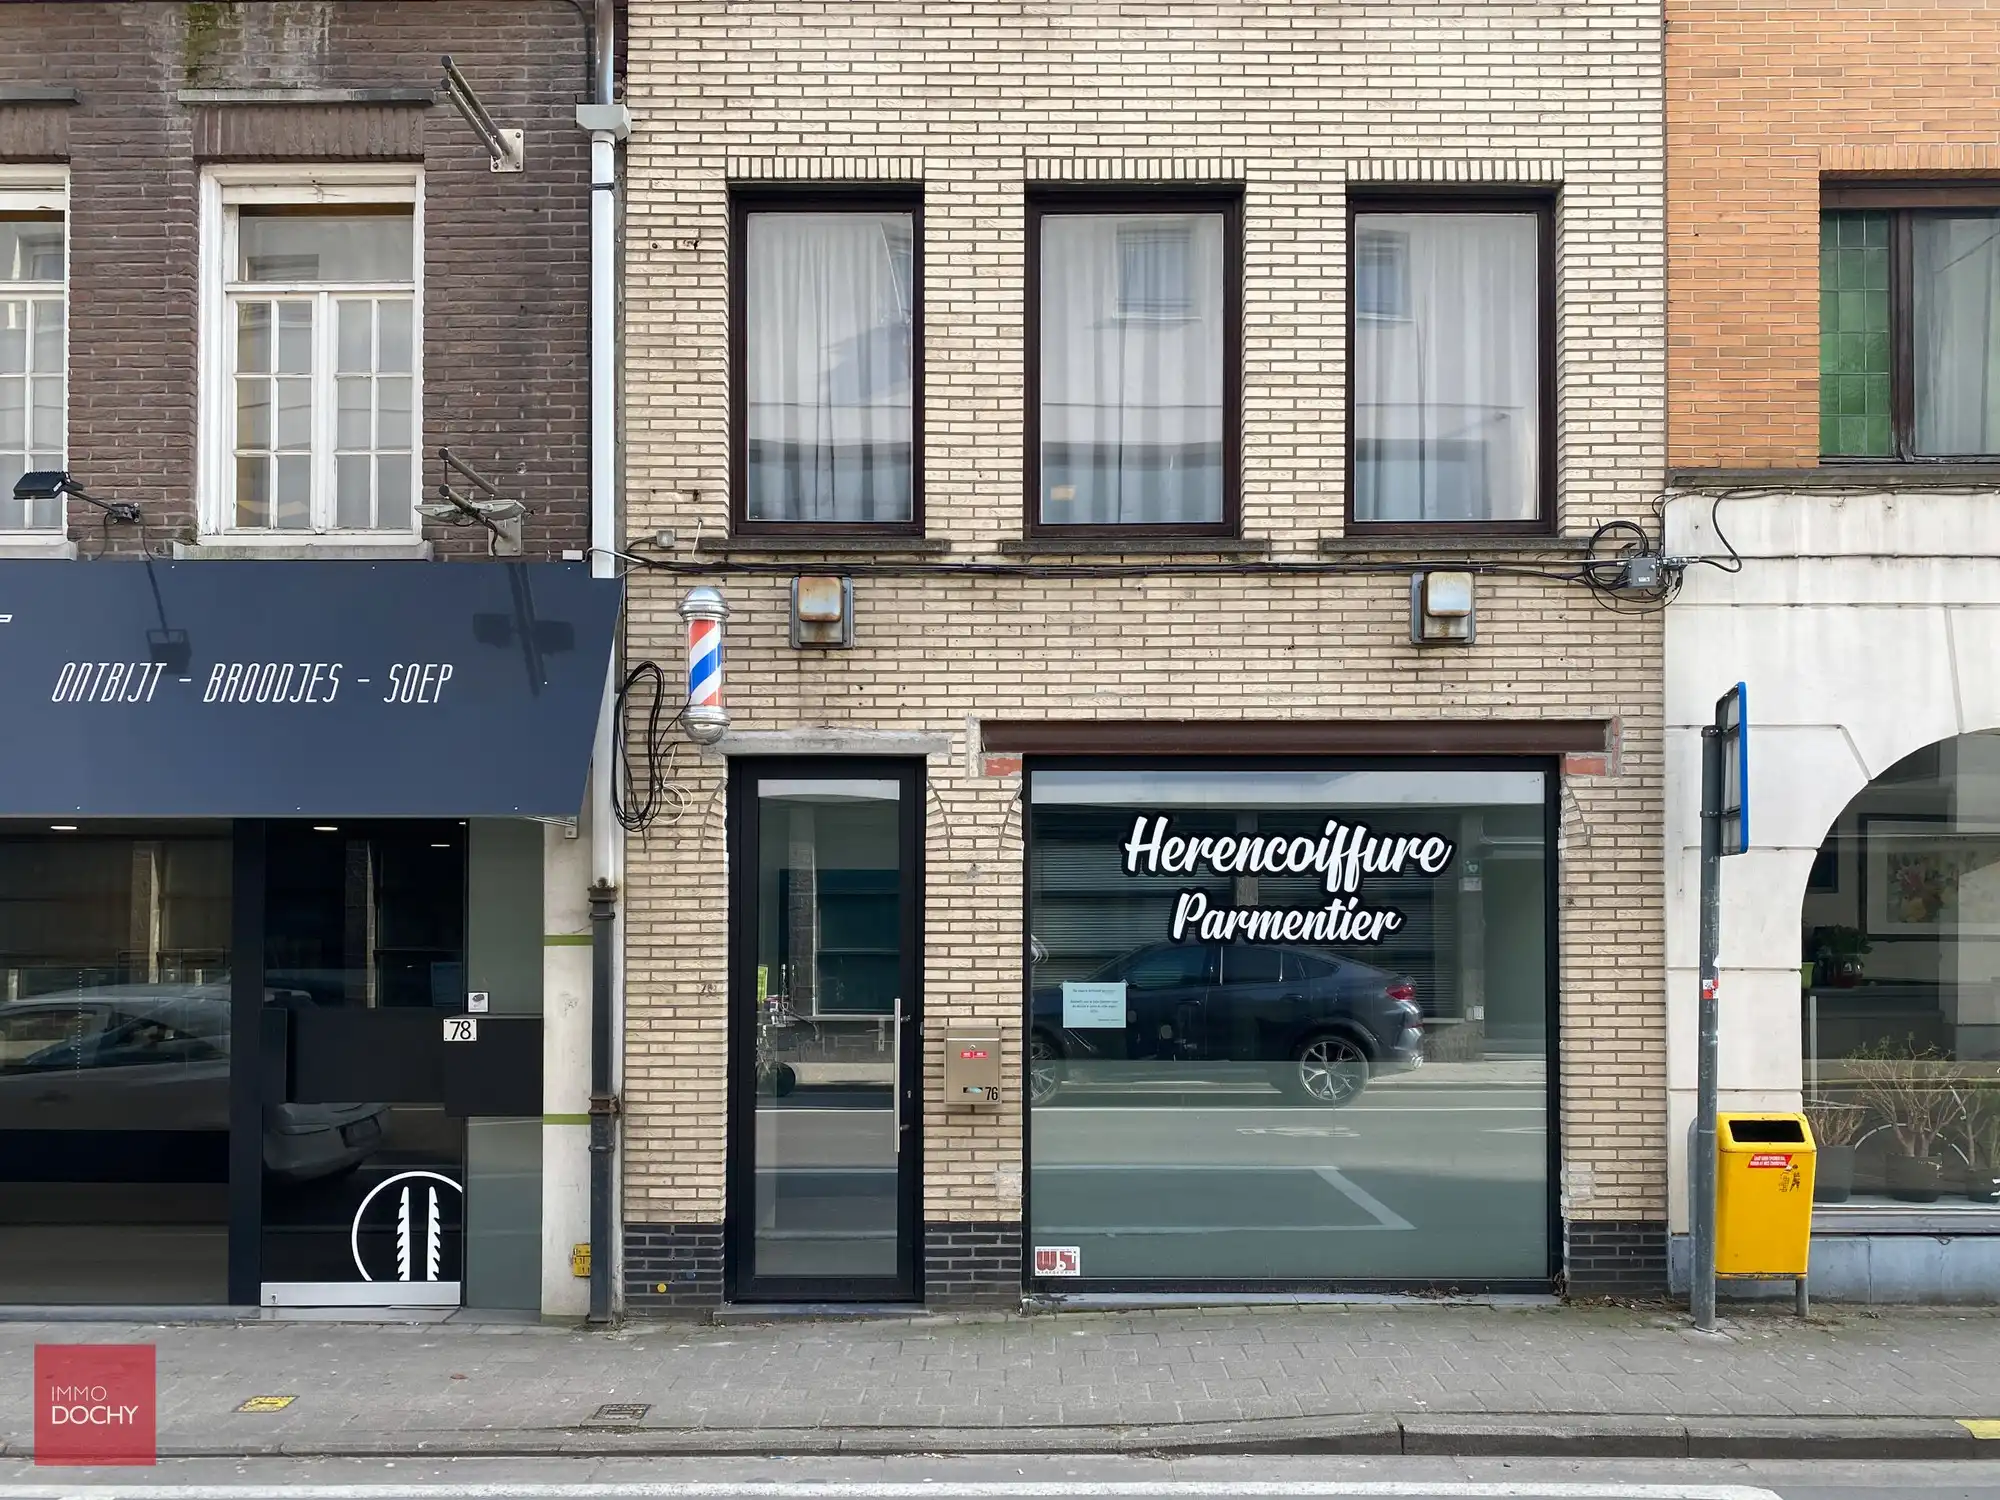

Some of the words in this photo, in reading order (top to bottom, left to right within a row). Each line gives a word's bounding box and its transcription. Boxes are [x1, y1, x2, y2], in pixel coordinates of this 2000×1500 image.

[51, 662, 168, 703] ONTBIJT
[202, 662, 344, 703] BROODJES
[383, 663, 454, 703] SOEP
[1123, 815, 1453, 893] Herencoiffure
[1172, 892, 1402, 941] Parmentier
[449, 1020, 472, 1040] 78
[984, 1086, 999, 1101] 76
